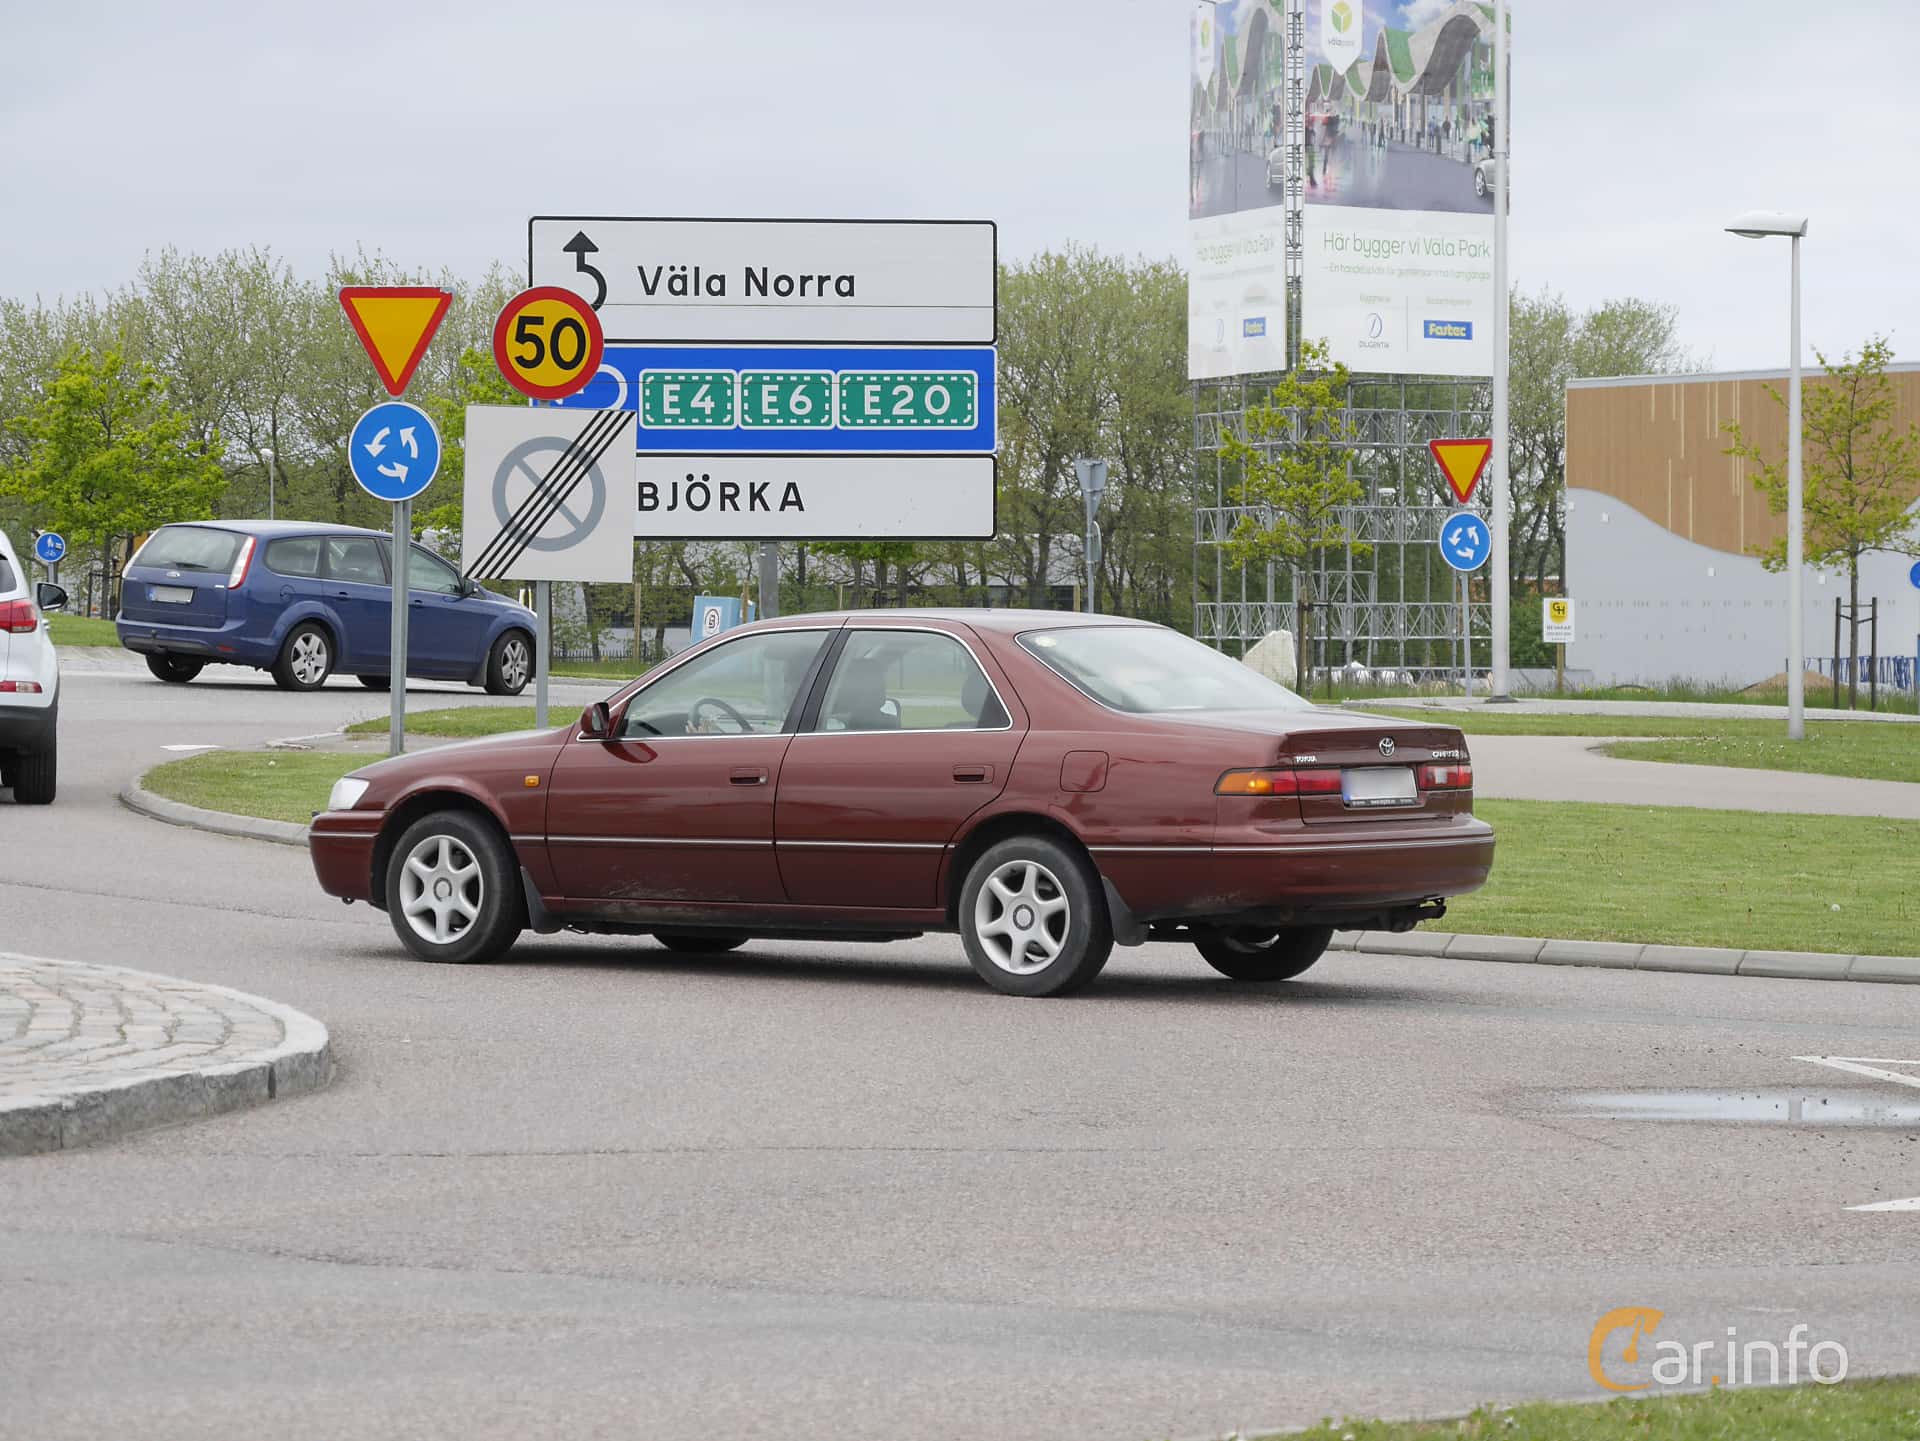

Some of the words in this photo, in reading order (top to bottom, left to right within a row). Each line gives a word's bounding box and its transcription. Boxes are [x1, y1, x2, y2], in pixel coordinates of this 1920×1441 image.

[1323, 231, 1350, 252] Här
[1353, 231, 1406, 259] bygger
[1409, 237, 1421, 256] vi
[1459, 239, 1491, 258] Park
[637, 265, 726, 297] Väla
[744, 266, 855, 298] Norra
[514, 315, 587, 371] 50
[1428, 322, 1467, 337] Fastec
[663, 383, 715, 415] E4
[761, 384, 813, 416] E6
[864, 384, 951, 416] E20
[637, 473, 805, 512] BJÖRKA
